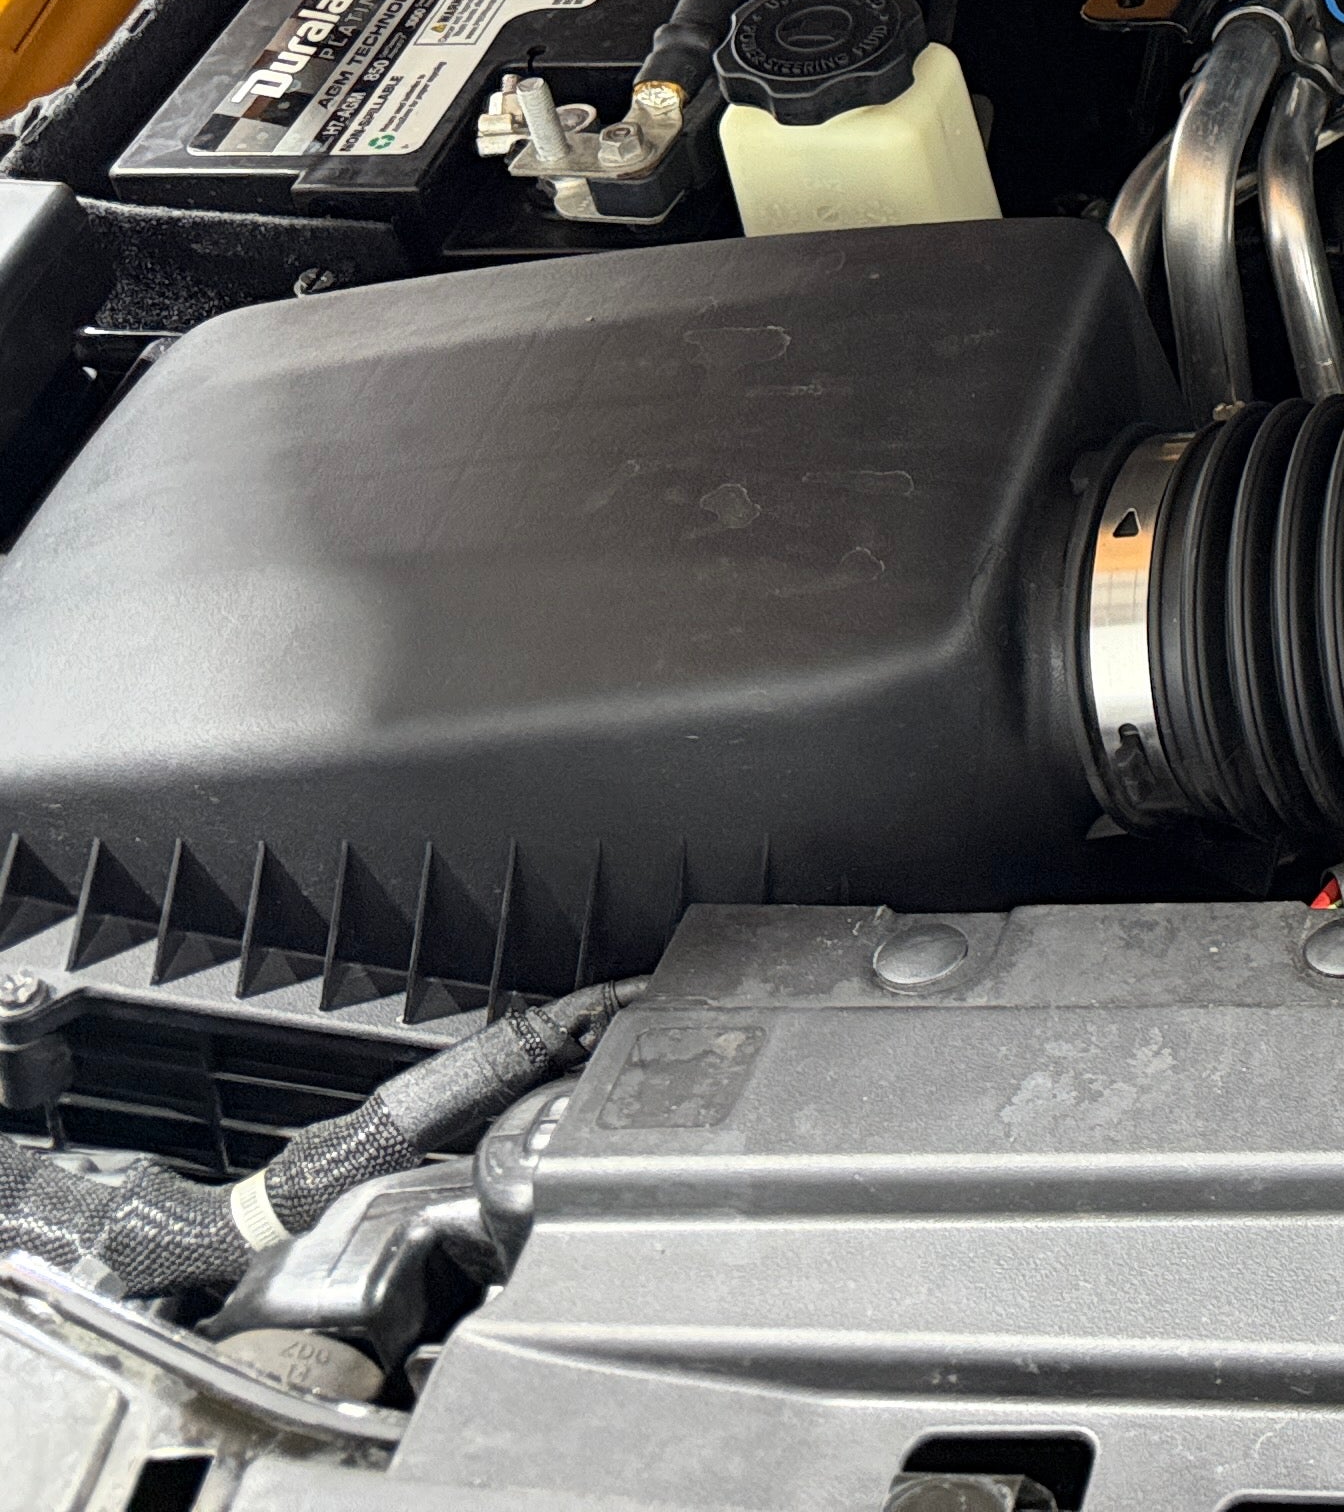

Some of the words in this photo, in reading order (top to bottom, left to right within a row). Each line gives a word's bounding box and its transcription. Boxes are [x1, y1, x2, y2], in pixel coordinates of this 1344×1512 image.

[317, 70, 354, 109] AGM
[322, 92, 367, 135] H7-AGM
[363, 59, 390, 81] 850
[339, 76, 404, 152] NON-SPILLABLE
